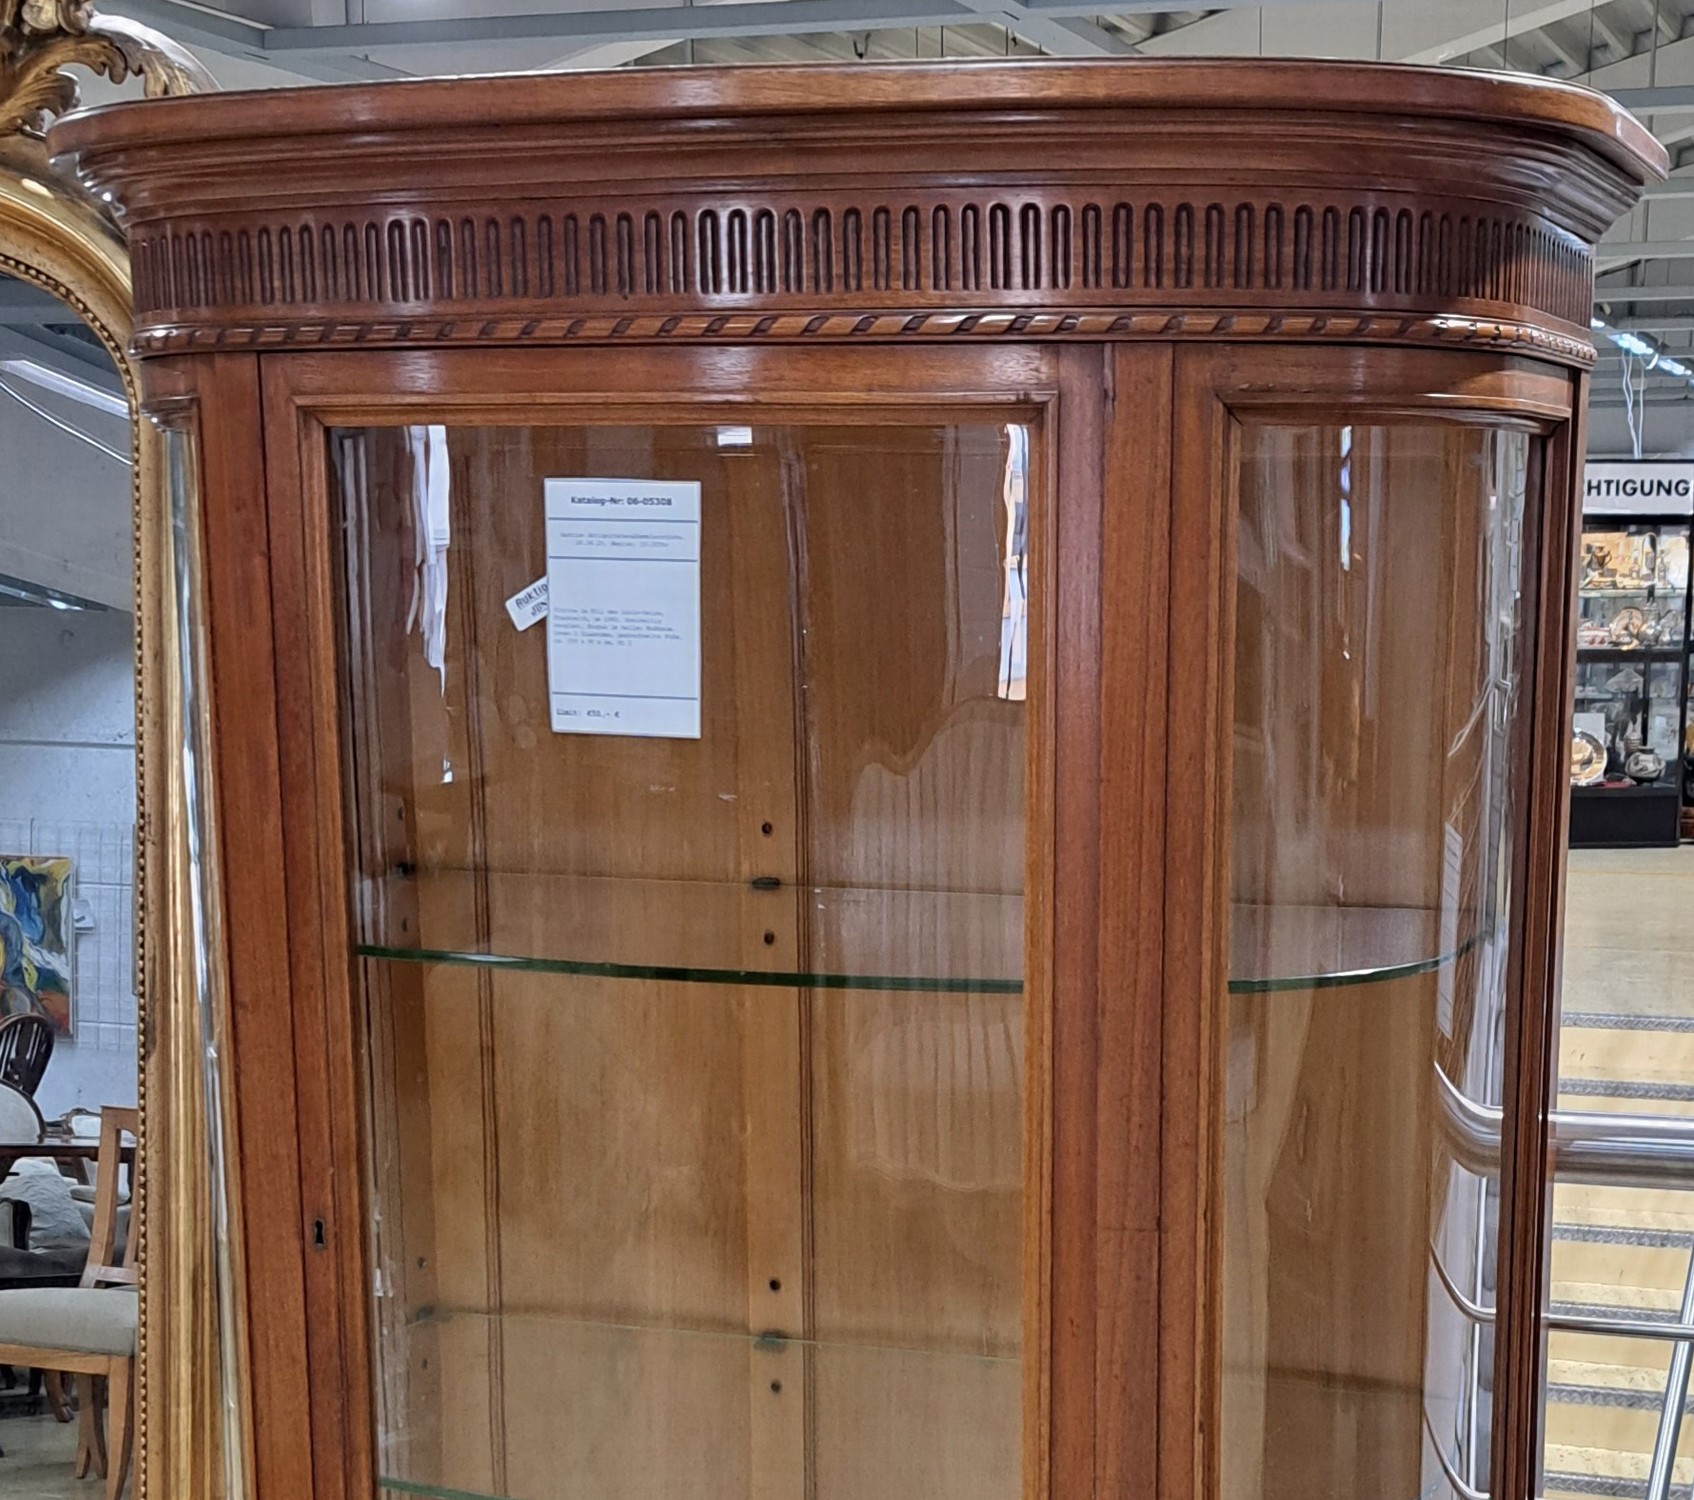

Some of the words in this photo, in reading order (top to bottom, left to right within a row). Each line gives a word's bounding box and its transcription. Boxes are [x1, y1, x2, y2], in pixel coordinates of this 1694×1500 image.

[1587, 479, 1691, 497] HTIGUNG
[571, 496, 624, 507] Katalog-Nr:
[515, 583, 548, 611] Auktio
